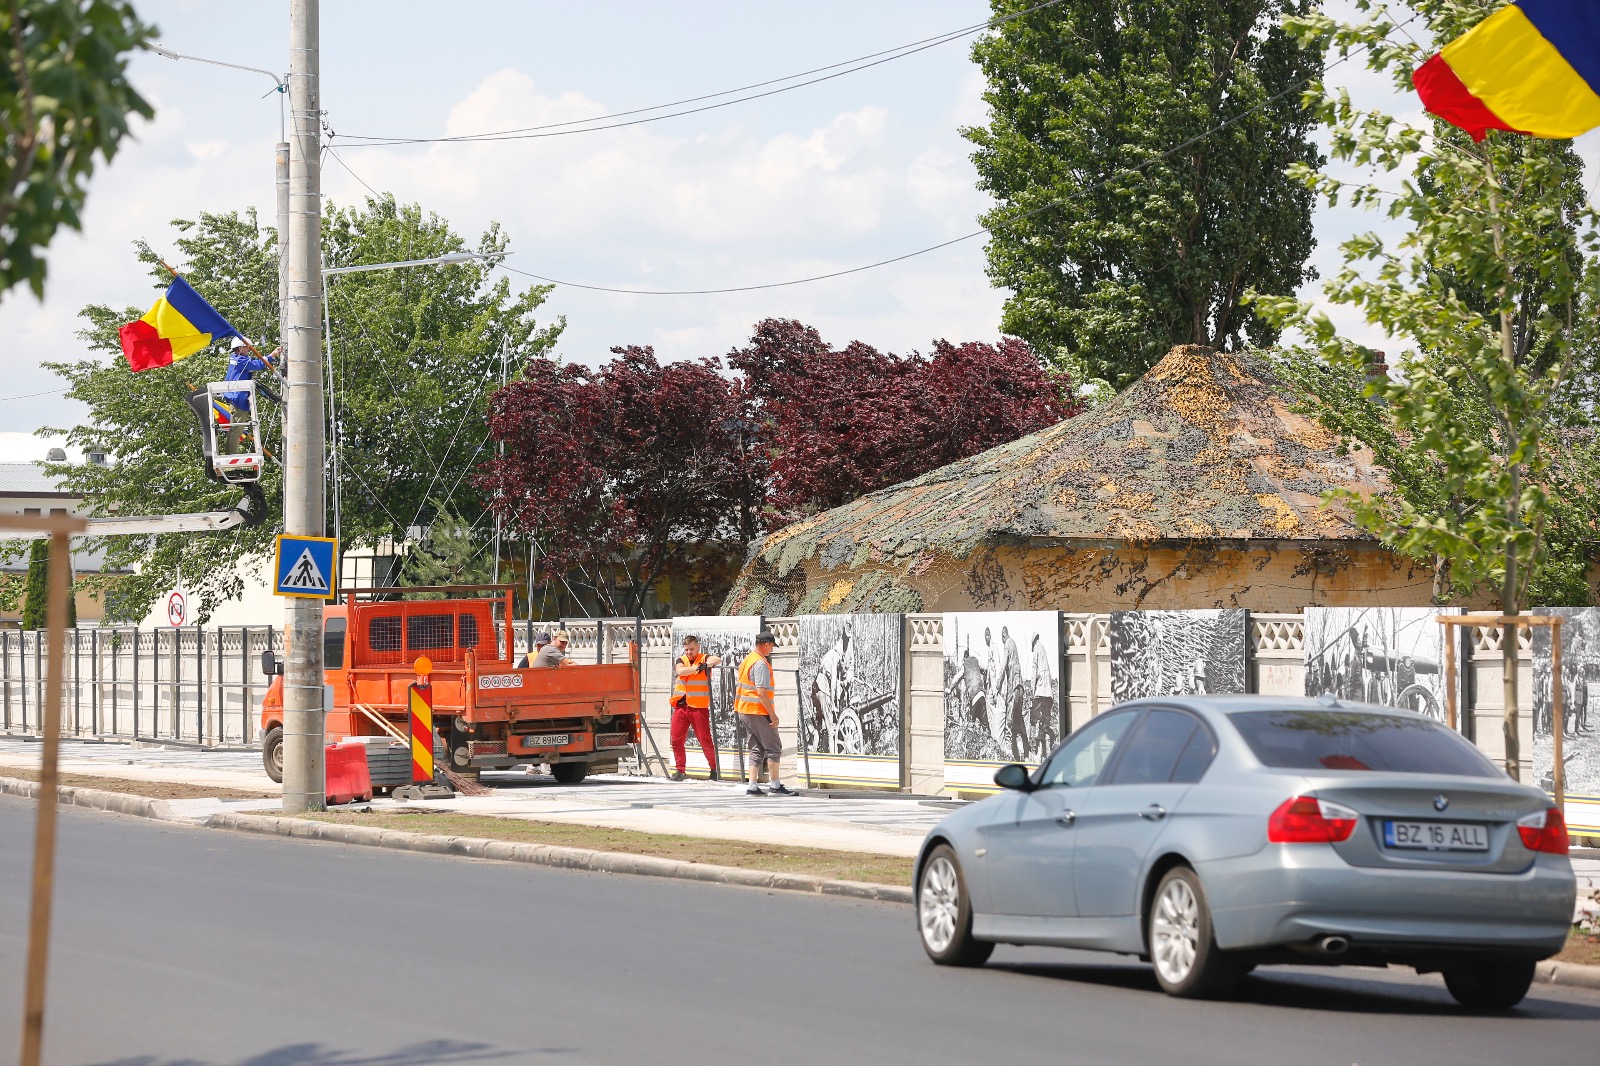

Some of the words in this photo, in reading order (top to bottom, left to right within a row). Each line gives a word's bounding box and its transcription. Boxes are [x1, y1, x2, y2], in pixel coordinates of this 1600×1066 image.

[529, 736, 541, 746] BZ
[1397, 824, 1422, 843] BZ
[1428, 826, 1445, 844] 16
[1451, 827, 1484, 846] ALL
